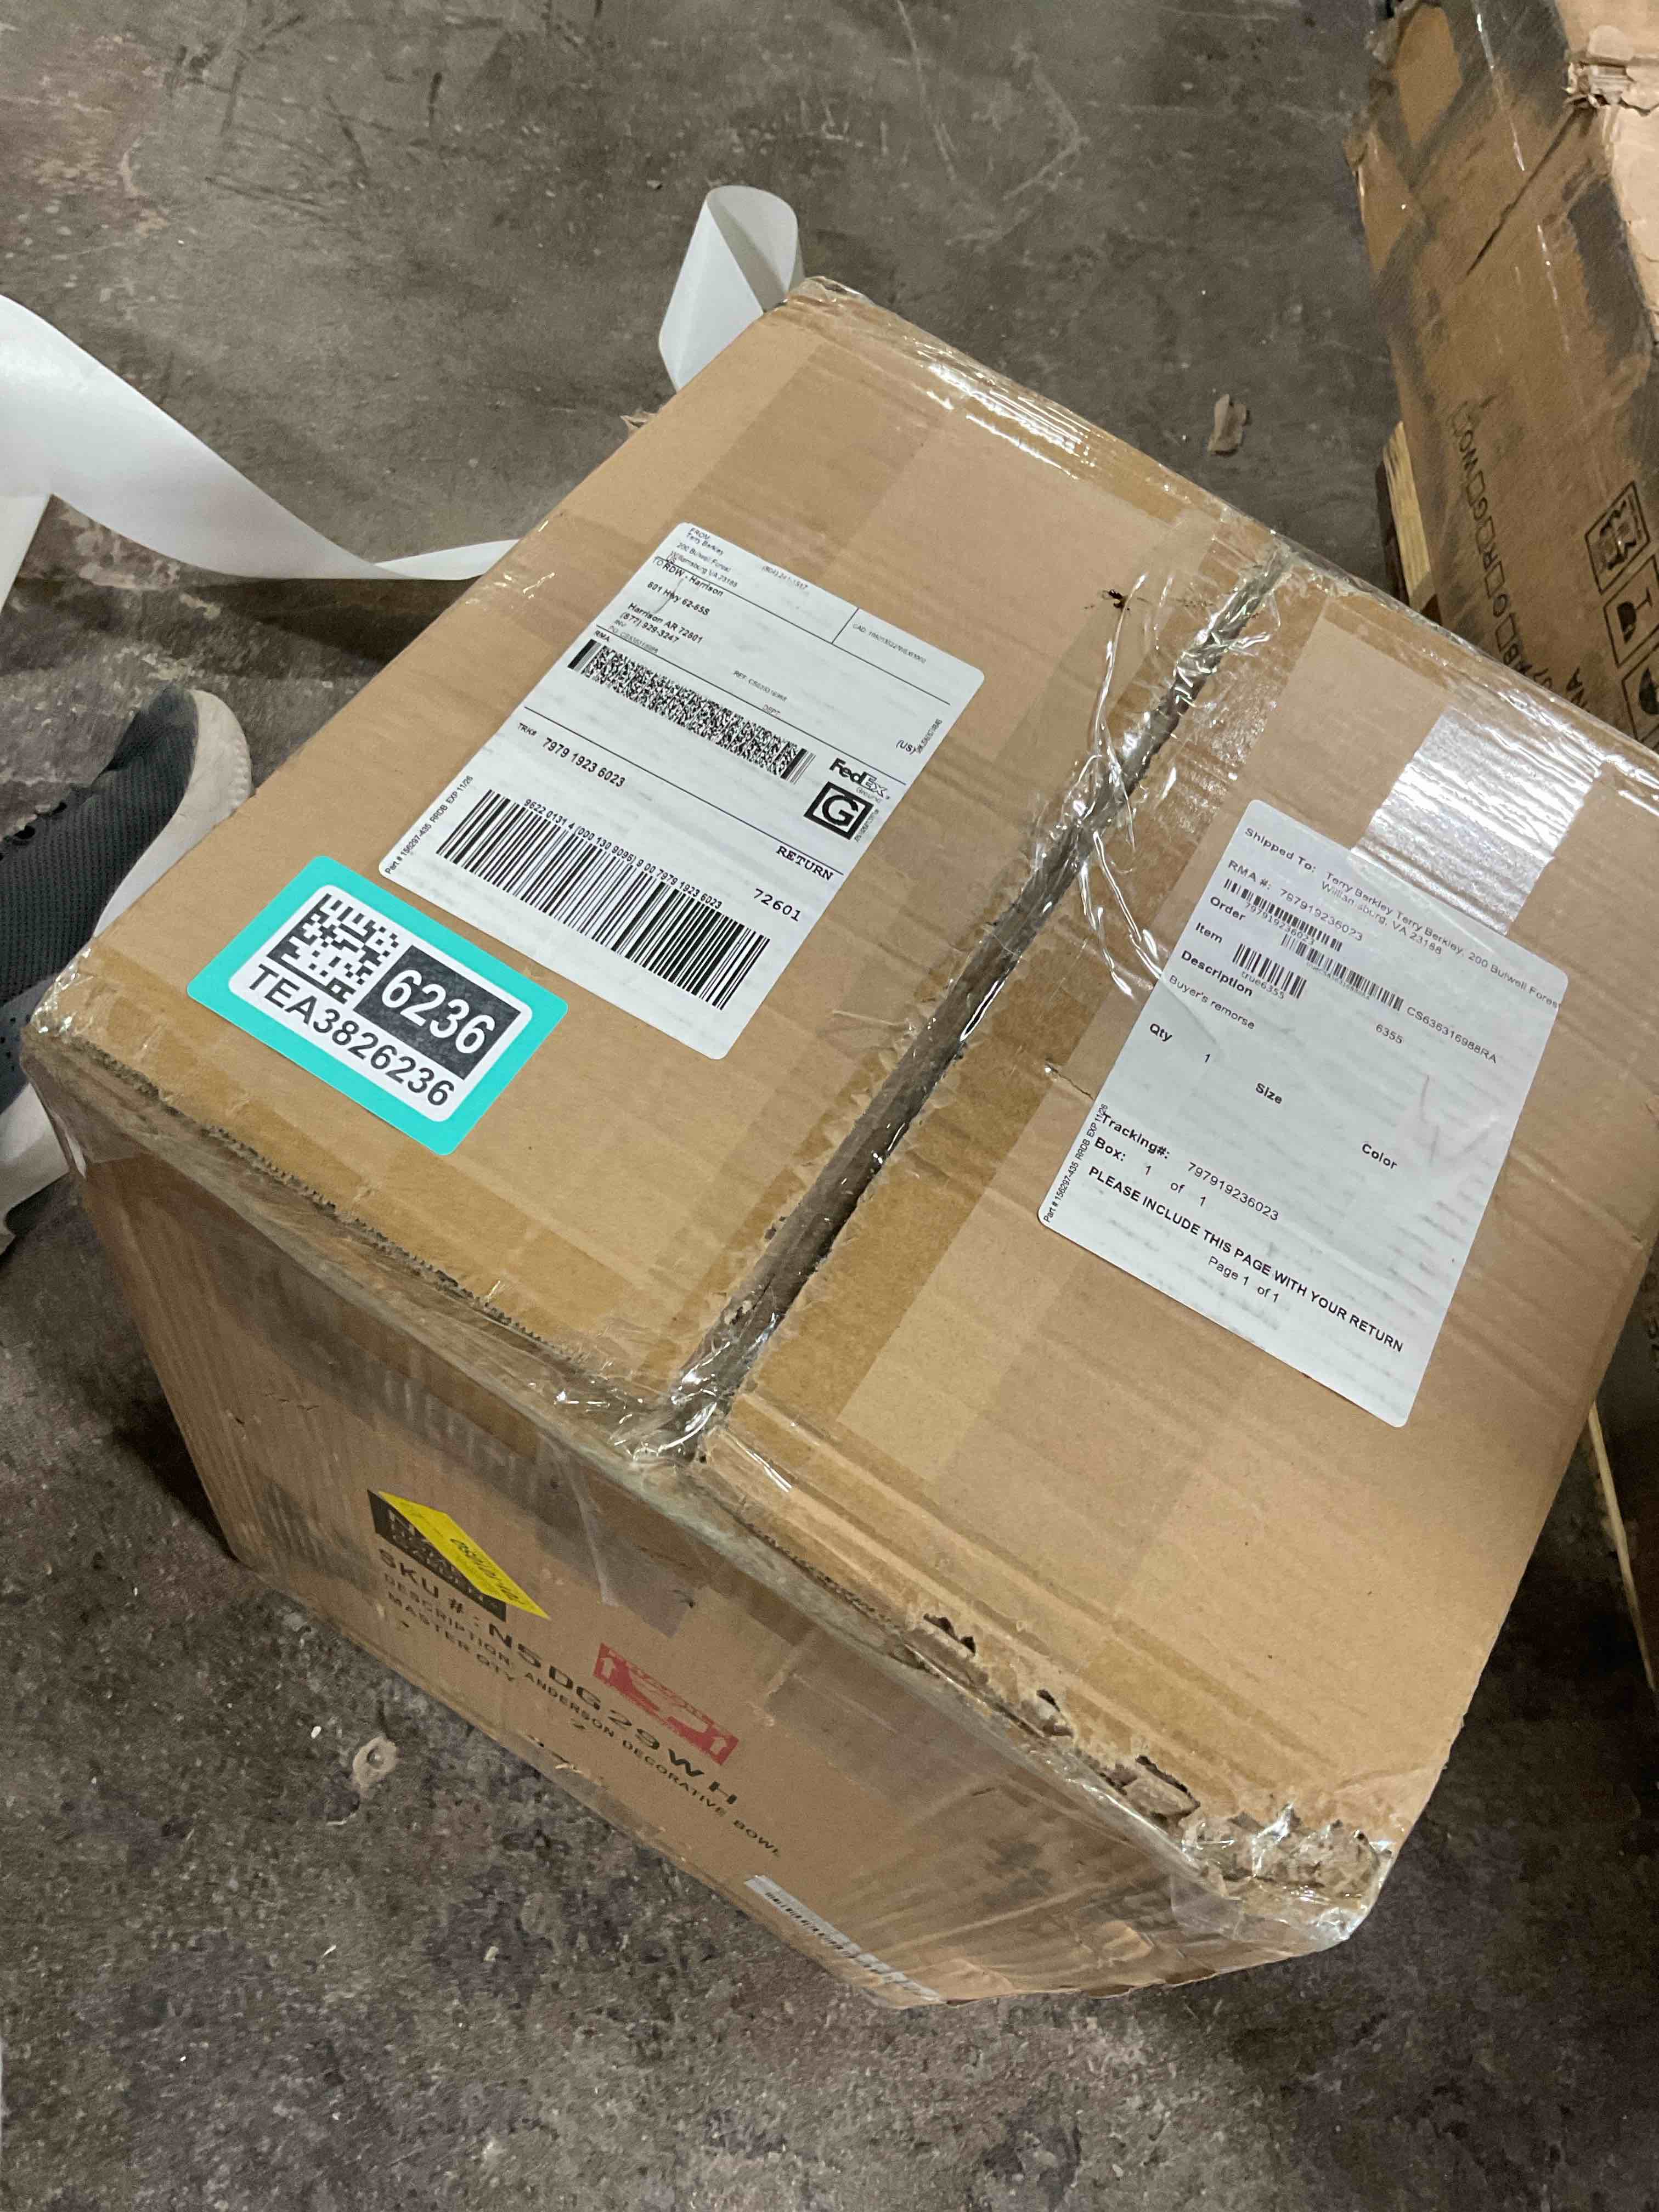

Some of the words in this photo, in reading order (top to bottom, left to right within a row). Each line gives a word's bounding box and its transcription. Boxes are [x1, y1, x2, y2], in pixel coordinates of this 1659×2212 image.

[646, 580, 664, 592] 601
[661, 562, 686, 578] RDW
[687, 575, 725, 597] Harrison
[618, 611, 644, 627] (877)
[641, 620, 680, 644] 929-3247
[627, 602, 665, 624] Harrison
[662, 619, 679, 631] AR
[676, 626, 704, 644] 72601
[539, 736, 572, 759] 7979
[567, 752, 600, 774] 1923
[595, 766, 628, 788] 6023
[894, 737, 919, 757] (US)
[444, 789, 461, 805] EXP
[827, 757, 892, 798] FedEx
[522, 798, 548, 815] 9622
[544, 809, 568, 827] 0131
[593, 836, 613, 851] 130
[654, 868, 680, 887] 7979
[676, 881, 702, 898] 1923
[698, 892, 724, 910] 6023
[774, 844, 836, 882] RETURN
[1227, 859, 1260, 883] RMA
[749, 887, 804, 922] 72601
[1243, 826, 1295, 862] Shipped
[1295, 855, 1318, 873] To:
[1323, 871, 1354, 894] Terry
[1353, 887, 1395, 917] Berkley
[1394, 910, 1424, 933] Terry
[1467, 950, 1489, 969] 200
[1390, 920, 1409, 936] VA
[1408, 930, 1443, 956] 23188
[1179, 949, 1255, 999] Description
[1194, 921, 1224, 944] Item
[1374, 1022, 1404, 1046] 6355
[1208, 894, 1247, 922] Order
[1405, 1005, 1499, 1064] CS636316988RA
[1240, 969, 1286, 1000] true6355
[381, 969, 496, 1055] 6236
[1167, 974, 1210, 1005] Buyer's
[1209, 998, 1256, 1030] remorse
[247, 964, 455, 1106] TEA3826236
[1147, 1021, 1173, 1044] Qty
[1254, 1081, 1284, 1105] Size
[1359, 1141, 1399, 1171] Color
[1042, 1205, 1057, 1224] Part
[1053, 1160, 1080, 1203] 156297-435
[1074, 1137, 1091, 1161] RRDB
[1085, 1121, 1099, 1139] EXP
[1093, 1135, 1128, 1163] Box:
[1169, 1178, 1187, 1196] of
[1099, 1112, 1172, 1163] Tracking#:
[1186, 1160, 1281, 1222] 797919236023
[1087, 1165, 1142, 1203] PLEASE
[1142, 1194, 1201, 1237] INCLUDE
[1200, 1228, 1234, 1255] THIS
[1232, 1246, 1272, 1277] PAGE
[1271, 1269, 1309, 1298] WITH
[1307, 1289, 1349, 1321] YOUR
[1347, 1313, 1404, 1354] RETURN
[1206, 1255, 1240, 1283] Page
[1255, 1282, 1272, 1300] of
[379, 1548, 438, 1599] SKU
[524, 1672, 615, 1738] ANDERSON
[622, 1739, 727, 1816] DECORATIVE
[732, 1819, 781, 1858] BOWL
